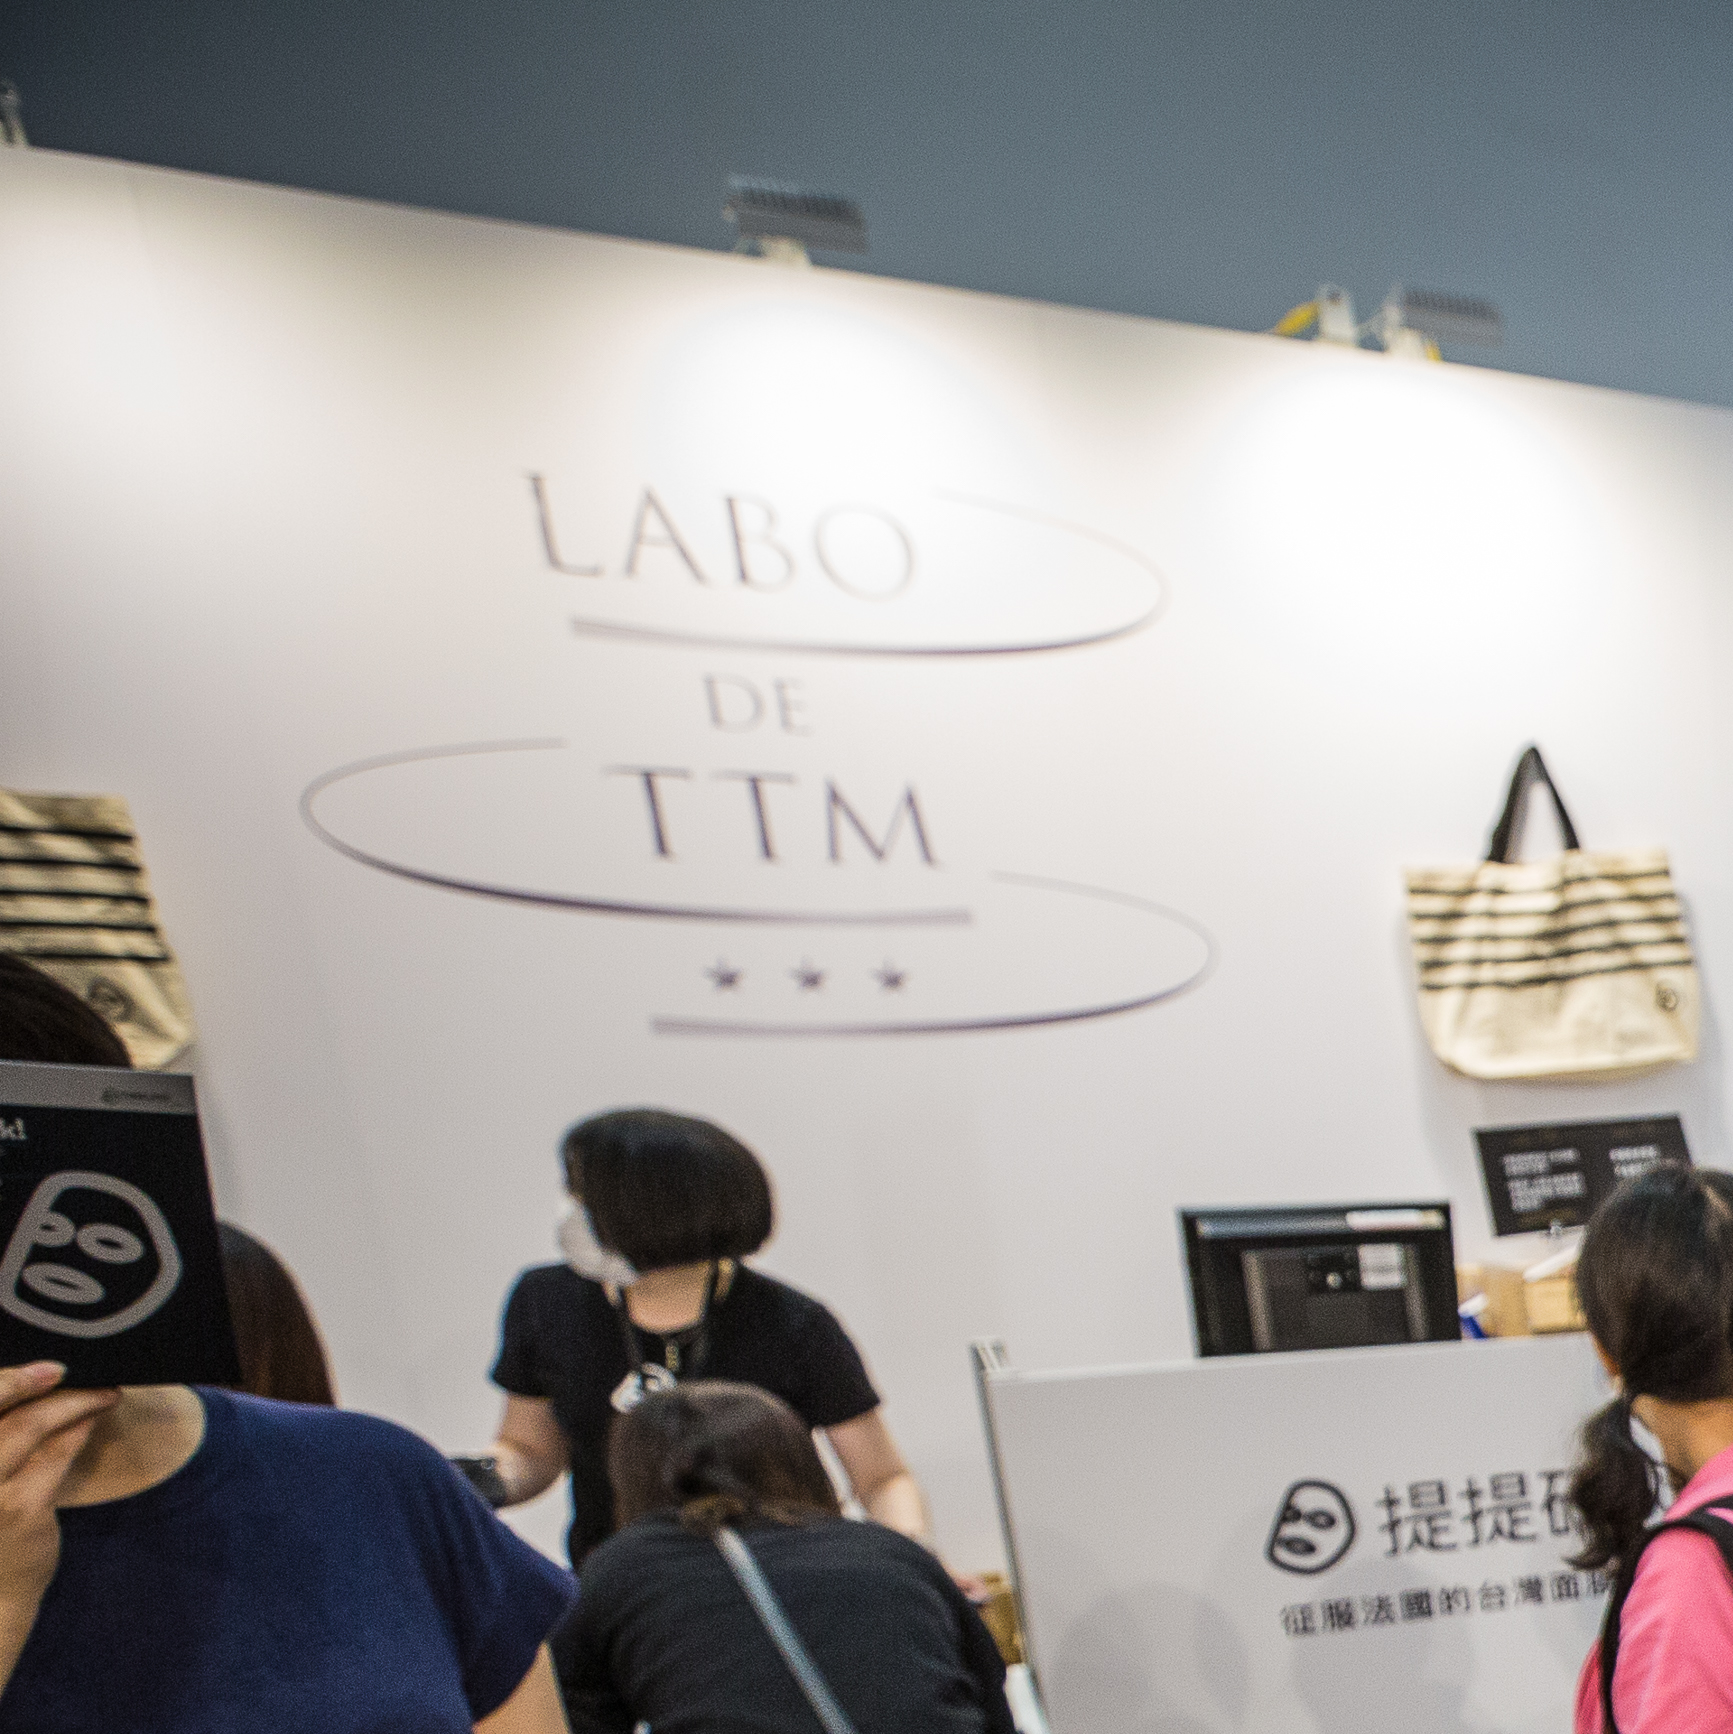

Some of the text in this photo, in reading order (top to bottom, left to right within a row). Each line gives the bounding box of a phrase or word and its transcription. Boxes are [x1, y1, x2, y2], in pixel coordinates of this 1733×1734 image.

[524, 468, 918, 600] LABO
[702, 672, 814, 736] DE
[601, 765, 943, 869] TTM
